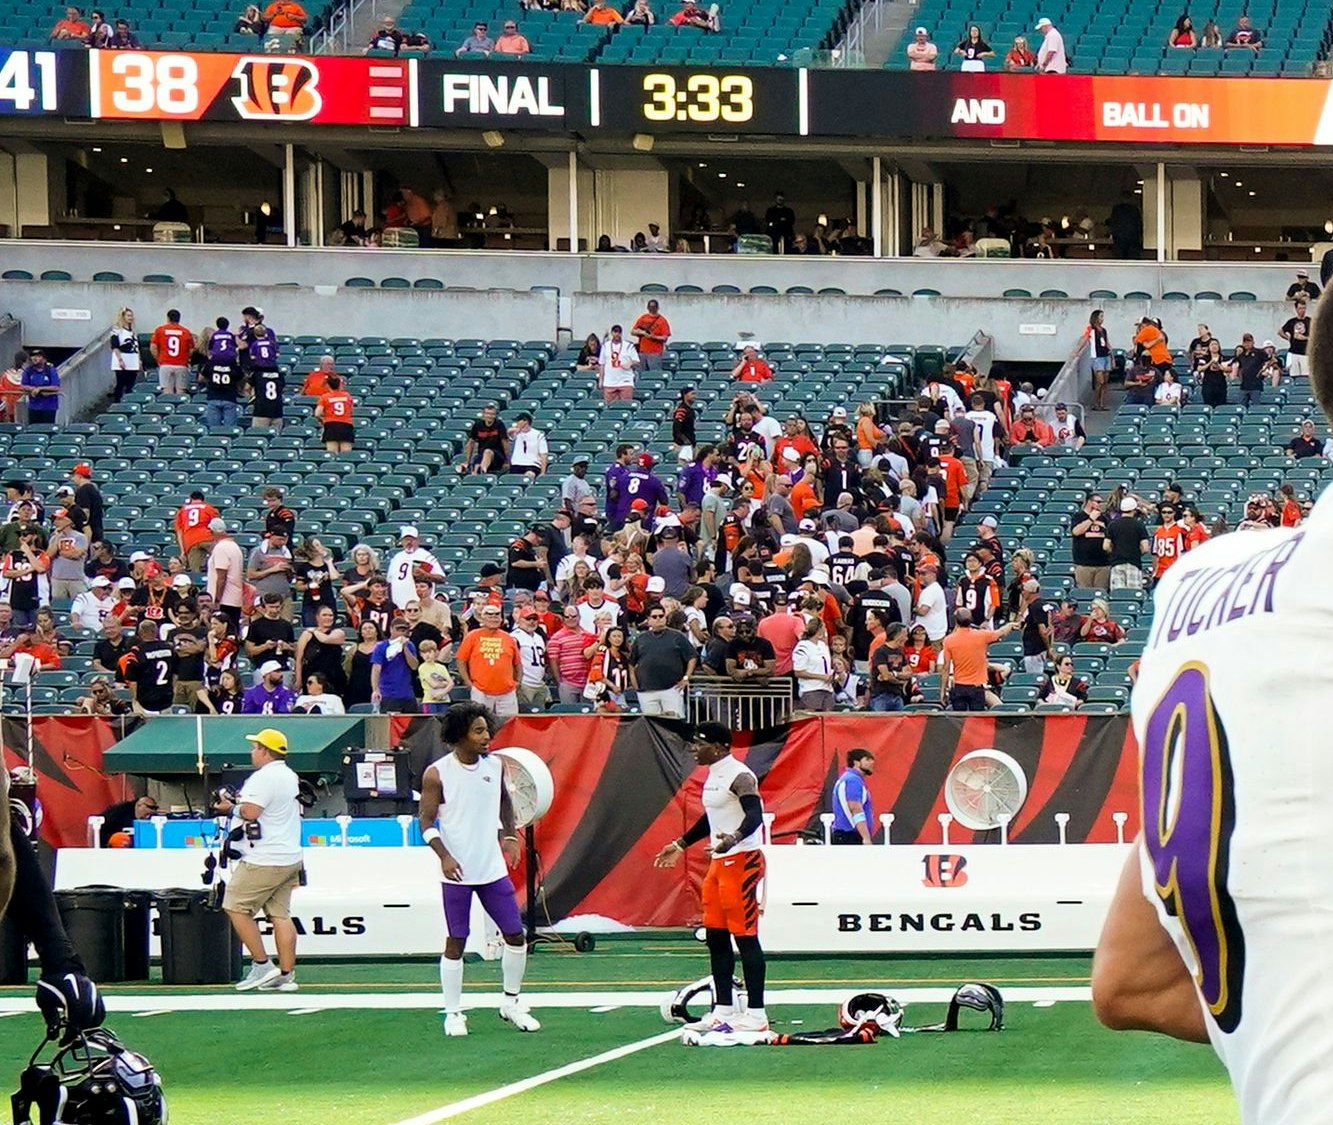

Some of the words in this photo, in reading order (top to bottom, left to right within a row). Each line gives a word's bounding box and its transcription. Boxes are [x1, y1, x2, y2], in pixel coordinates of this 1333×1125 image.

[1, 51, 57, 110] 41
[112, 53, 199, 114] 38
[442, 73, 565, 117] FINAL
[643, 74, 754, 122] 3:33
[951, 98, 1006, 124] AND
[1103, 102, 1169, 128] BALL
[1173, 104, 1210, 129] ON
[168, 336, 180, 357] 9
[266, 381, 277, 400] 8
[333, 403, 345, 416] 9
[628, 477, 641, 495] 8
[841, 471, 847, 489] 1
[188, 508, 200, 526] 9
[1158, 537, 1175, 557] 85
[398, 563, 408, 581] 9
[832, 566, 856, 586] 64
[966, 589, 977, 610] 9
[1154, 531, 1307, 650] TUCKER
[156, 661, 169, 686] 2
[611, 668, 629, 692] 11
[1141, 659, 1246, 1034] 9
[837, 912, 1043, 933] BENGALS
